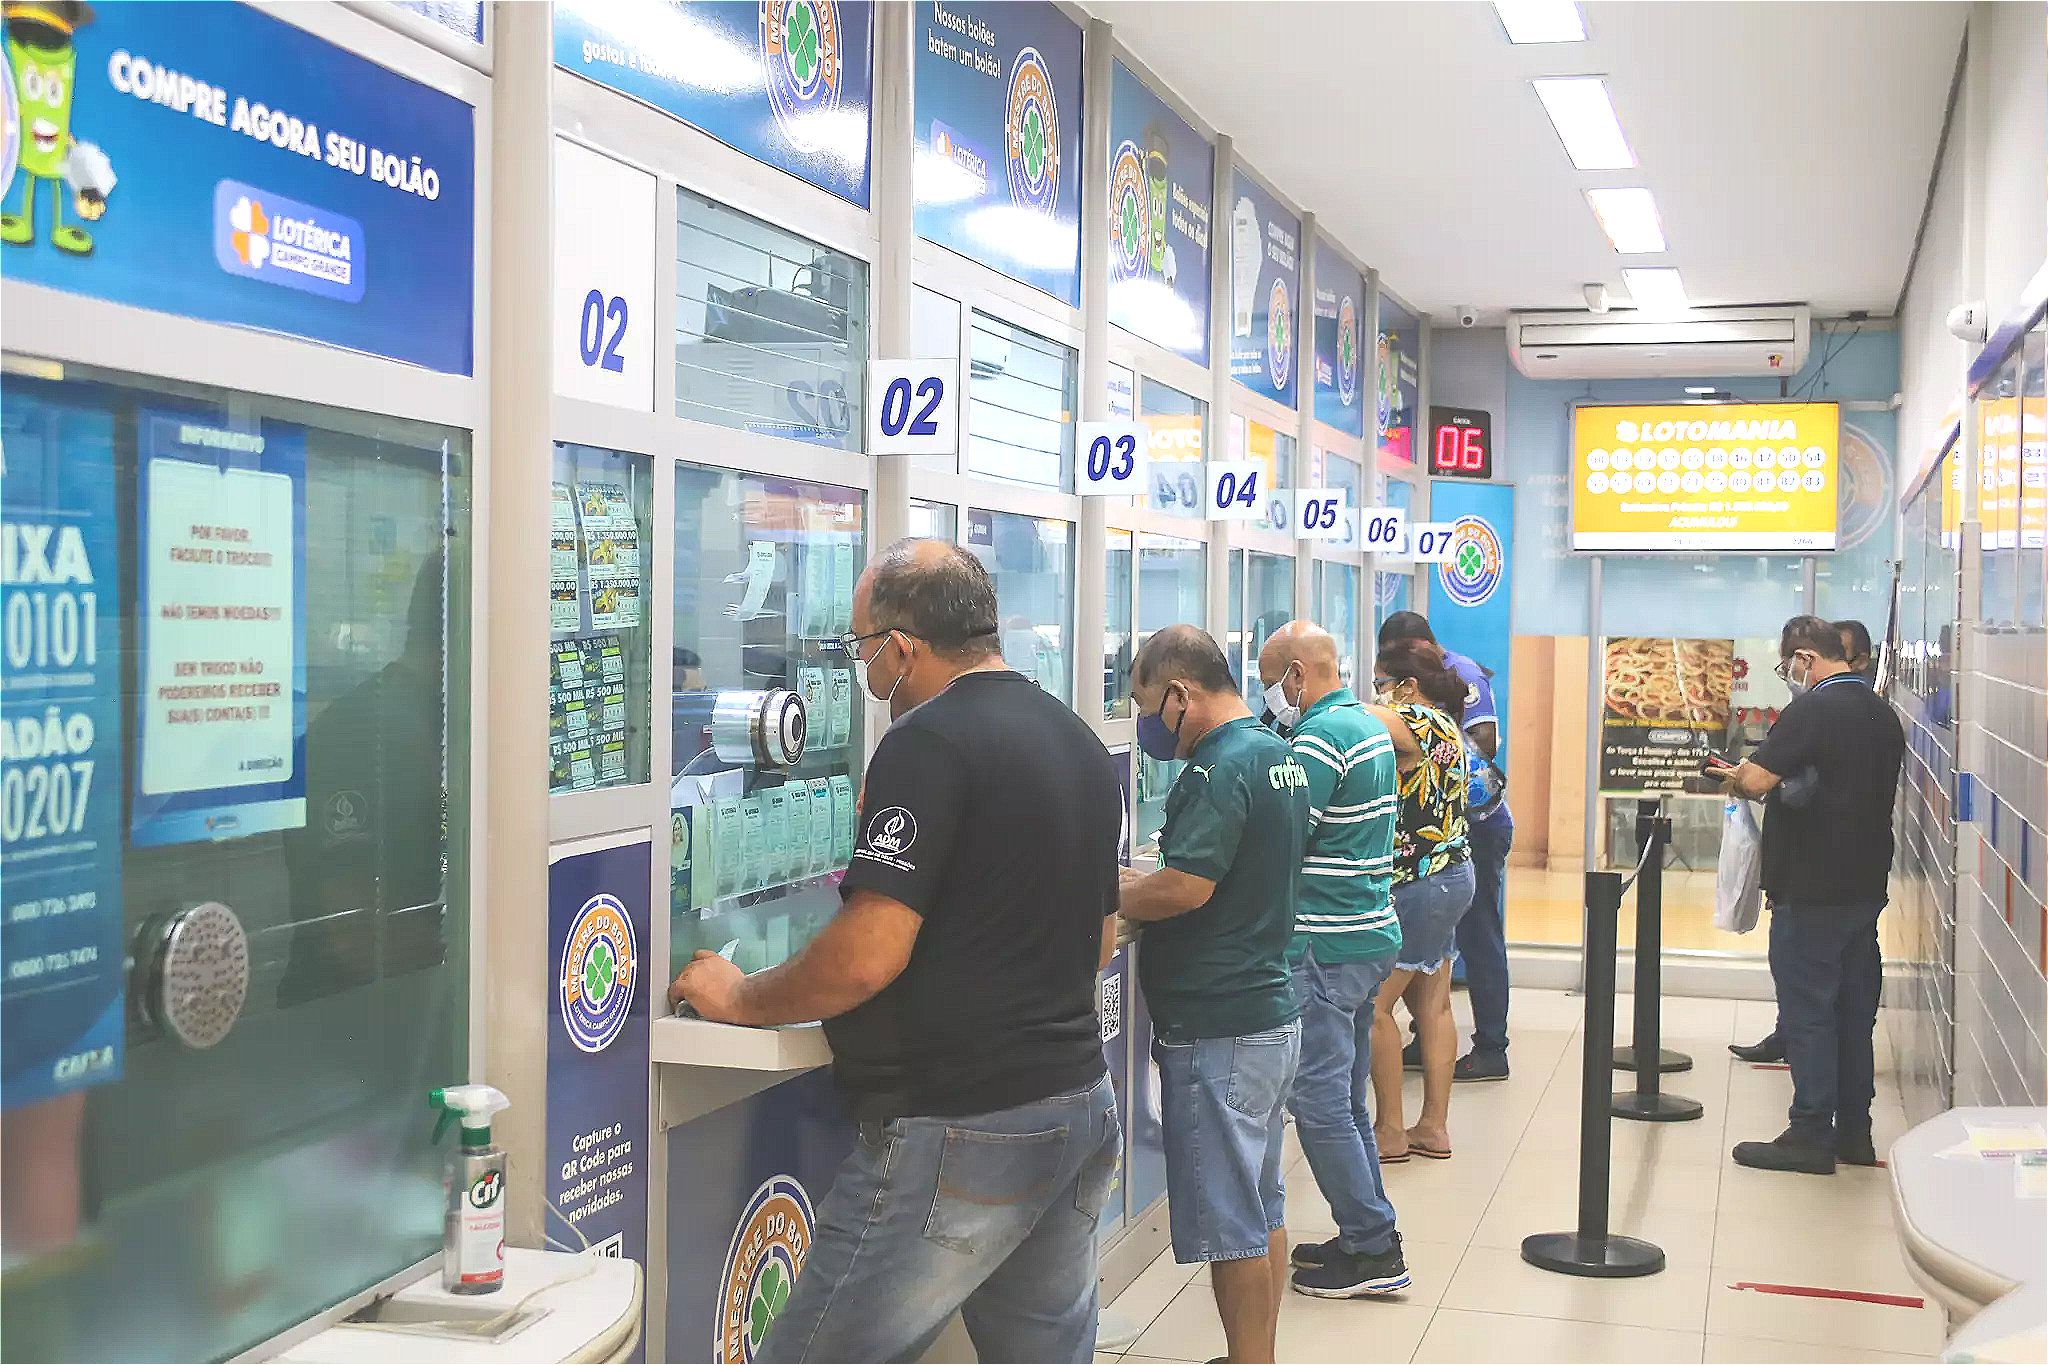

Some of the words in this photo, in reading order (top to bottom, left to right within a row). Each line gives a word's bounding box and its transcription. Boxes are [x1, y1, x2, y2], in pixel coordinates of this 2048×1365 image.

[934, 1, 966, 35] Nossos
[968, 15, 995, 47] bolões
[928, 28, 957, 59] batem
[959, 47, 973, 67] um
[975, 53, 1001, 79] bolão!
[108, 48, 228, 127] COMPRE
[231, 96, 322, 161] AGORA
[325, 129, 367, 176] SEU
[370, 147, 441, 202] BOLÃO
[1013, 73, 1031, 150] MESTRE
[1031, 74, 1042, 95] DO
[272, 214, 351, 261] LOTÉRICA
[580, 288, 629, 372] 02
[880, 376, 944, 438] 02
[1435, 425, 1484, 470] 06
[1640, 419, 1797, 441] LOTOMANIA
[1087, 435, 1135, 482] 03
[1805, 452, 1821, 462] 54
[1216, 471, 1257, 509] 04
[1781, 477, 1796, 486] 82
[1805, 476, 1821, 486] 83
[1303, 498, 1338, 529] 05
[1368, 517, 1398, 543] 06
[1419, 531, 1452, 555] 07
[6, 590, 97, 669] 0101
[162, 604, 183, 620] NÃO
[186, 606, 220, 620] TEMOS
[201, 661, 237, 676] TROCO
[240, 657, 263, 674] NÃO
[159, 683, 226, 700] PODEREMOS
[229, 682, 281, 698] RECEBER
[557, 693, 572, 703] 500
[585, 688, 596, 700] R$
[597, 686, 611, 697] 500
[612, 684, 625, 695] MIL
[553, 745, 562, 756] R$
[563, 741, 577, 753] 500
[596, 733, 611, 745] 500
[612, 730, 625, 742] MIL
[1, 761, 95, 843] 0207
[874, 833, 901, 848] ADM
[570, 920, 596, 993] MESTRE
[596, 915, 610, 931] DO
[611, 922, 629, 981] BOLÃO
[592, 1017, 609, 1030] CAMPO
[572, 1124, 612, 1153] Capture
[614, 1122, 622, 1136] o
[561, 1158, 578, 1181] QR
[579, 1151, 606, 1172] Code
[607, 1140, 632, 1166] para
[471, 1172, 500, 1206] Cif
[559, 1175, 597, 1206] receber
[599, 1161, 633, 1188] nossas
[568, 1188, 624, 1224] novidades.
[730, 1225, 764, 1361] MESTRE
[766, 1211, 785, 1238] DO
